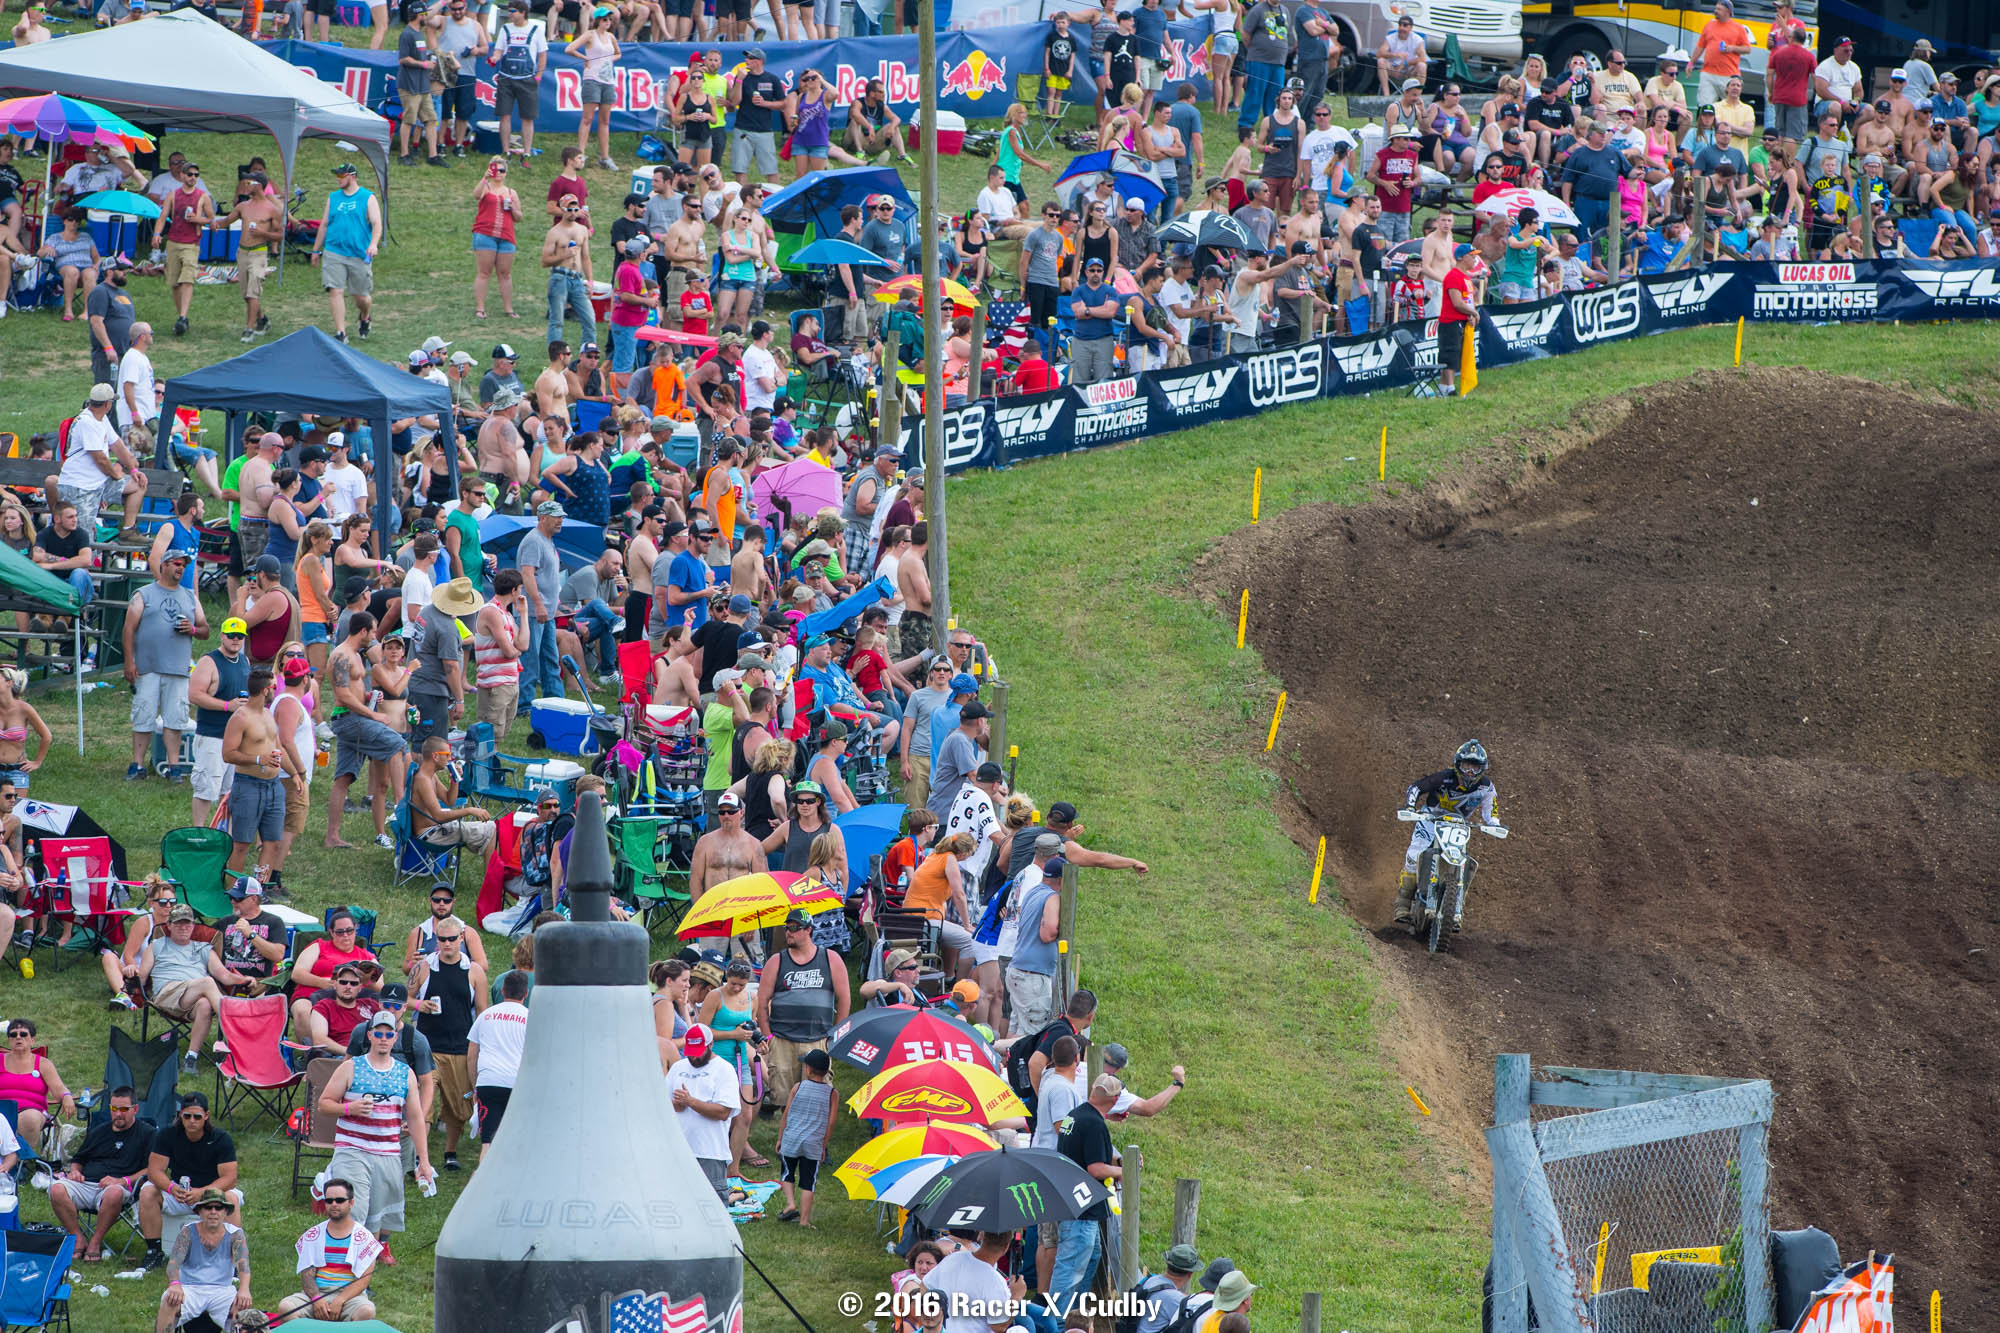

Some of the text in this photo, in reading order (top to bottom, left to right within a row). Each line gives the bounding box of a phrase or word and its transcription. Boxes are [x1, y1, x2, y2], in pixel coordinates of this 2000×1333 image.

[1783, 265, 1852, 281] LUCAS OIL
[1648, 272, 1735, 310] FLY
[1754, 291, 1878, 310] MOTOCROSS
[1661, 303, 1706, 318] RACING
[1934, 297, 2000, 306] RACIN
[1490, 303, 1565, 341] FLY
[1571, 281, 1641, 343] WPS
[1753, 308, 1878, 318] CHAMPIONSHIP
[1507, 335, 1547, 350] RACING
[1331, 336, 1399, 375] FLY
[1248, 344, 1323, 407] WPS
[1346, 368, 1388, 384] RACING
[1088, 378, 1136, 405] LUCAS OIL
[1159, 366, 1239, 407] FLY
[1176, 400, 1220, 416] RACING
[995, 398, 1066, 439] FLY
[1074, 405, 1148, 436] MOTOCROSS
[1003, 432, 1047, 448] RACING
[1074, 423, 1148, 445] CHAMPIONSHIP
[964, 807, 974, 819] G
[1440, 826, 1468, 846] 16
[493, 1012, 526, 1024] YAMAHA
[985, 1099, 999, 1113] FEEL
[998, 1089, 1012, 1103] THE
[496, 1199, 683, 1230] LUCAS
[1656, 1251, 1699, 1261] ACERBIS
